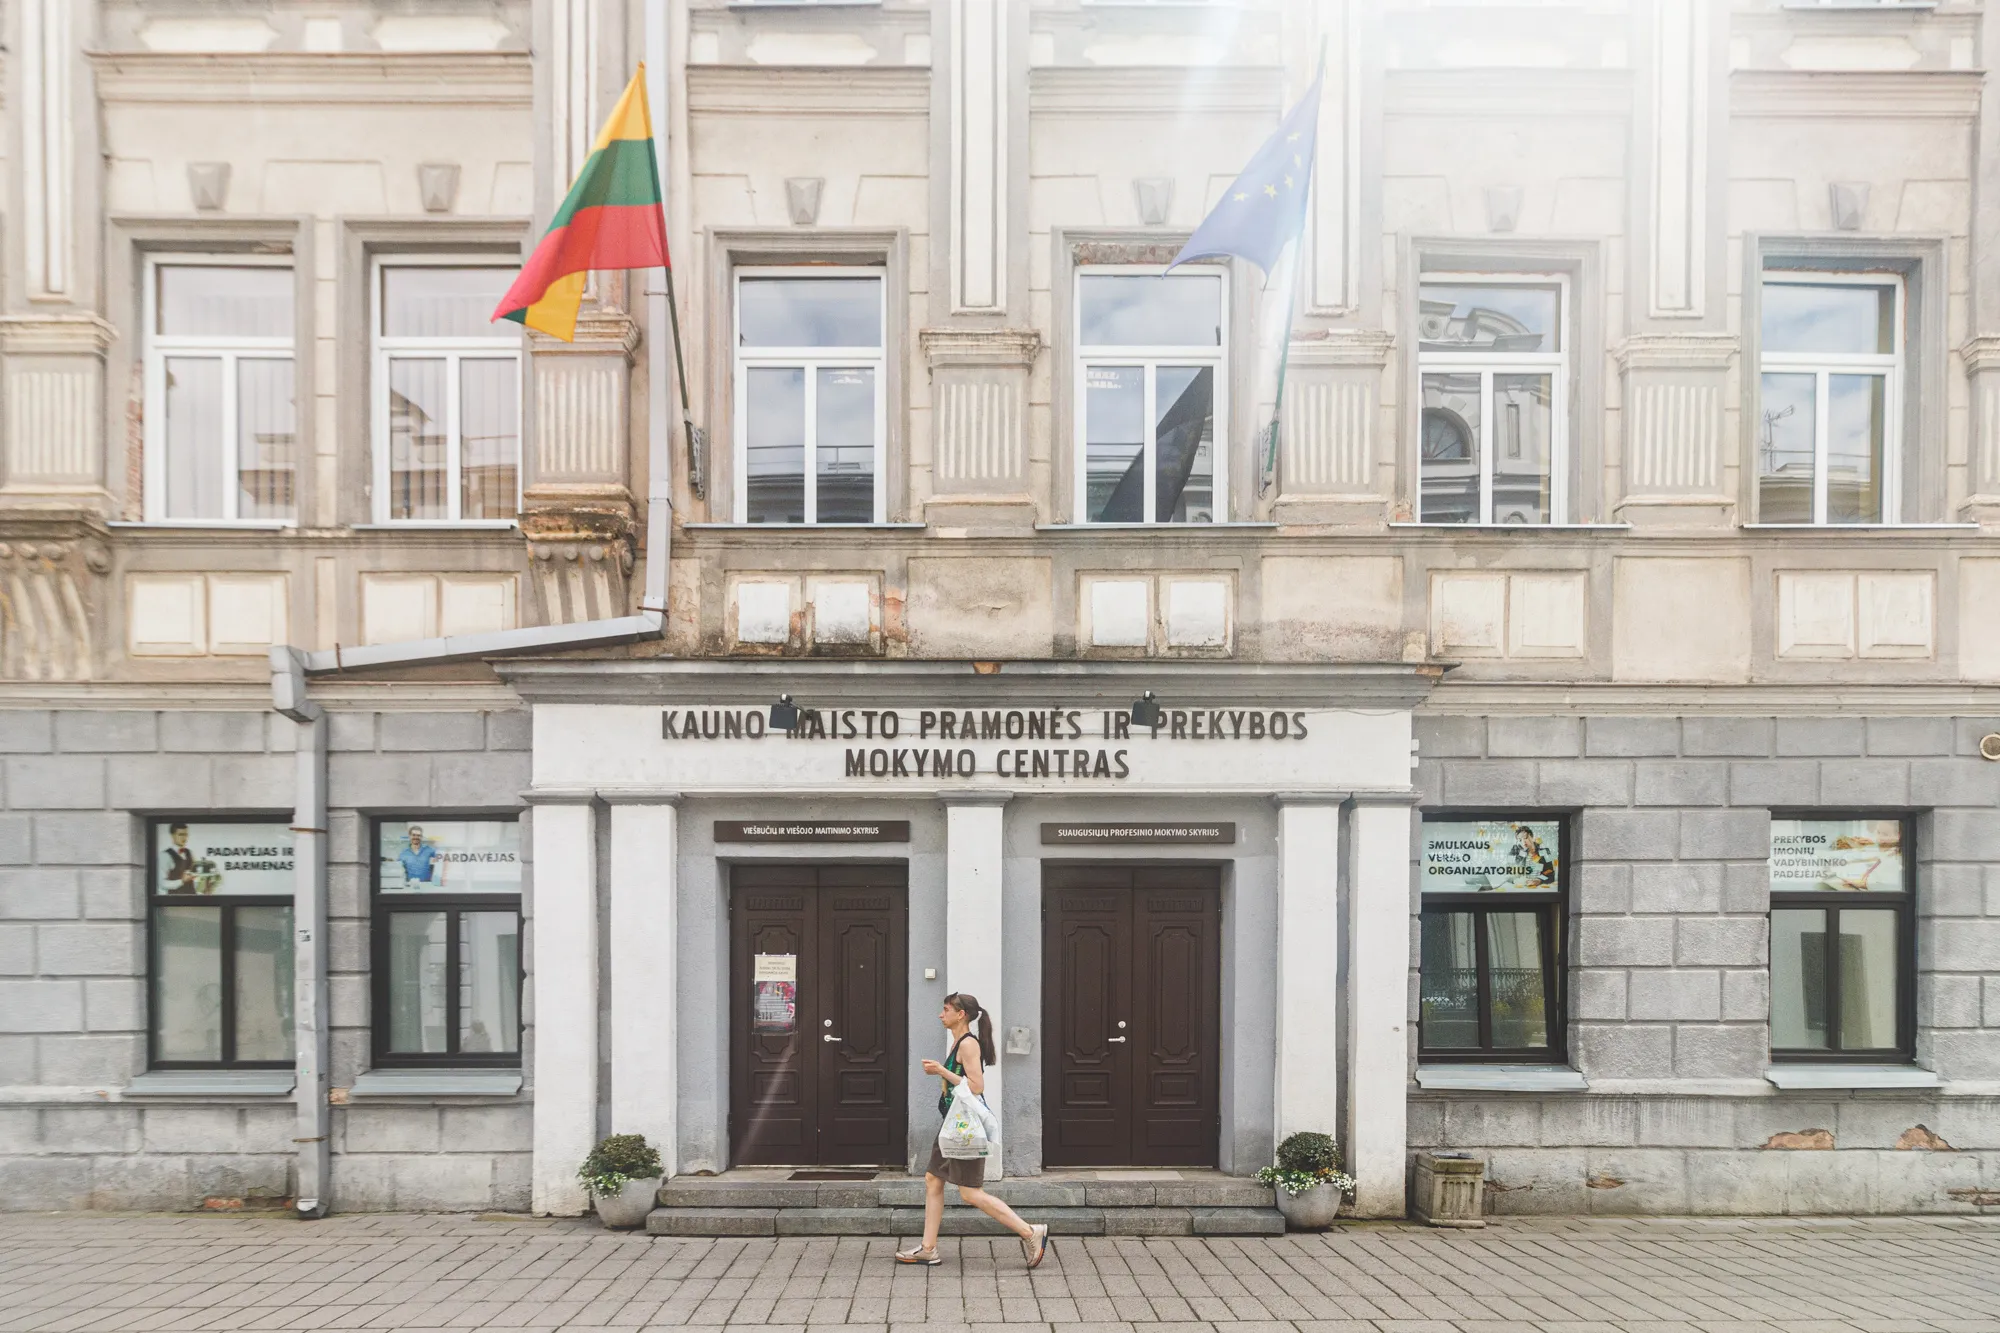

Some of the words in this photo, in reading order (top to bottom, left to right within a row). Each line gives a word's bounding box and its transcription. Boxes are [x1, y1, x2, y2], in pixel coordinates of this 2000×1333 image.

[662, 710, 765, 740] KAUNO
[786, 710, 900, 740] MAISTO
[920, 705, 1082, 740] PRAMONĖS
[1103, 711, 1130, 740] IR
[1150, 710, 1308, 740] PREKYBOS
[845, 749, 976, 778] MOKYMO
[997, 749, 1130, 779] CENTRAS
[742, 826, 777, 836] VIEŠBUČIŲ
[778, 827, 785, 835] IR
[786, 826, 814, 835] VIEŠOJO
[815, 827, 852, 835] MAITINIMO
[852, 827, 880, 835] SKYRIUS
[1057, 828, 1109, 838] SUAUGUSIŲJŲ
[1110, 828, 1153, 837] PROFESINIO
[1154, 828, 1188, 837] MOKYMO
[1188, 828, 1220, 837] SKYRIUS
[1773, 835, 1827, 844] PREKYBOS
[1428, 840, 1490, 850] SMULKAUS
[206, 845, 278, 857] PADAVĖJAS
[281, 847, 294, 857] IR
[435, 852, 515, 863] PARDAVĖJAS
[1773, 858, 1847, 867] VADYBININKO
[224, 861, 295, 871] BARMENAS
[1428, 866, 1532, 876] ORGANIZATORIUS
[1773, 868, 1828, 879] PADĖJĖJAS
